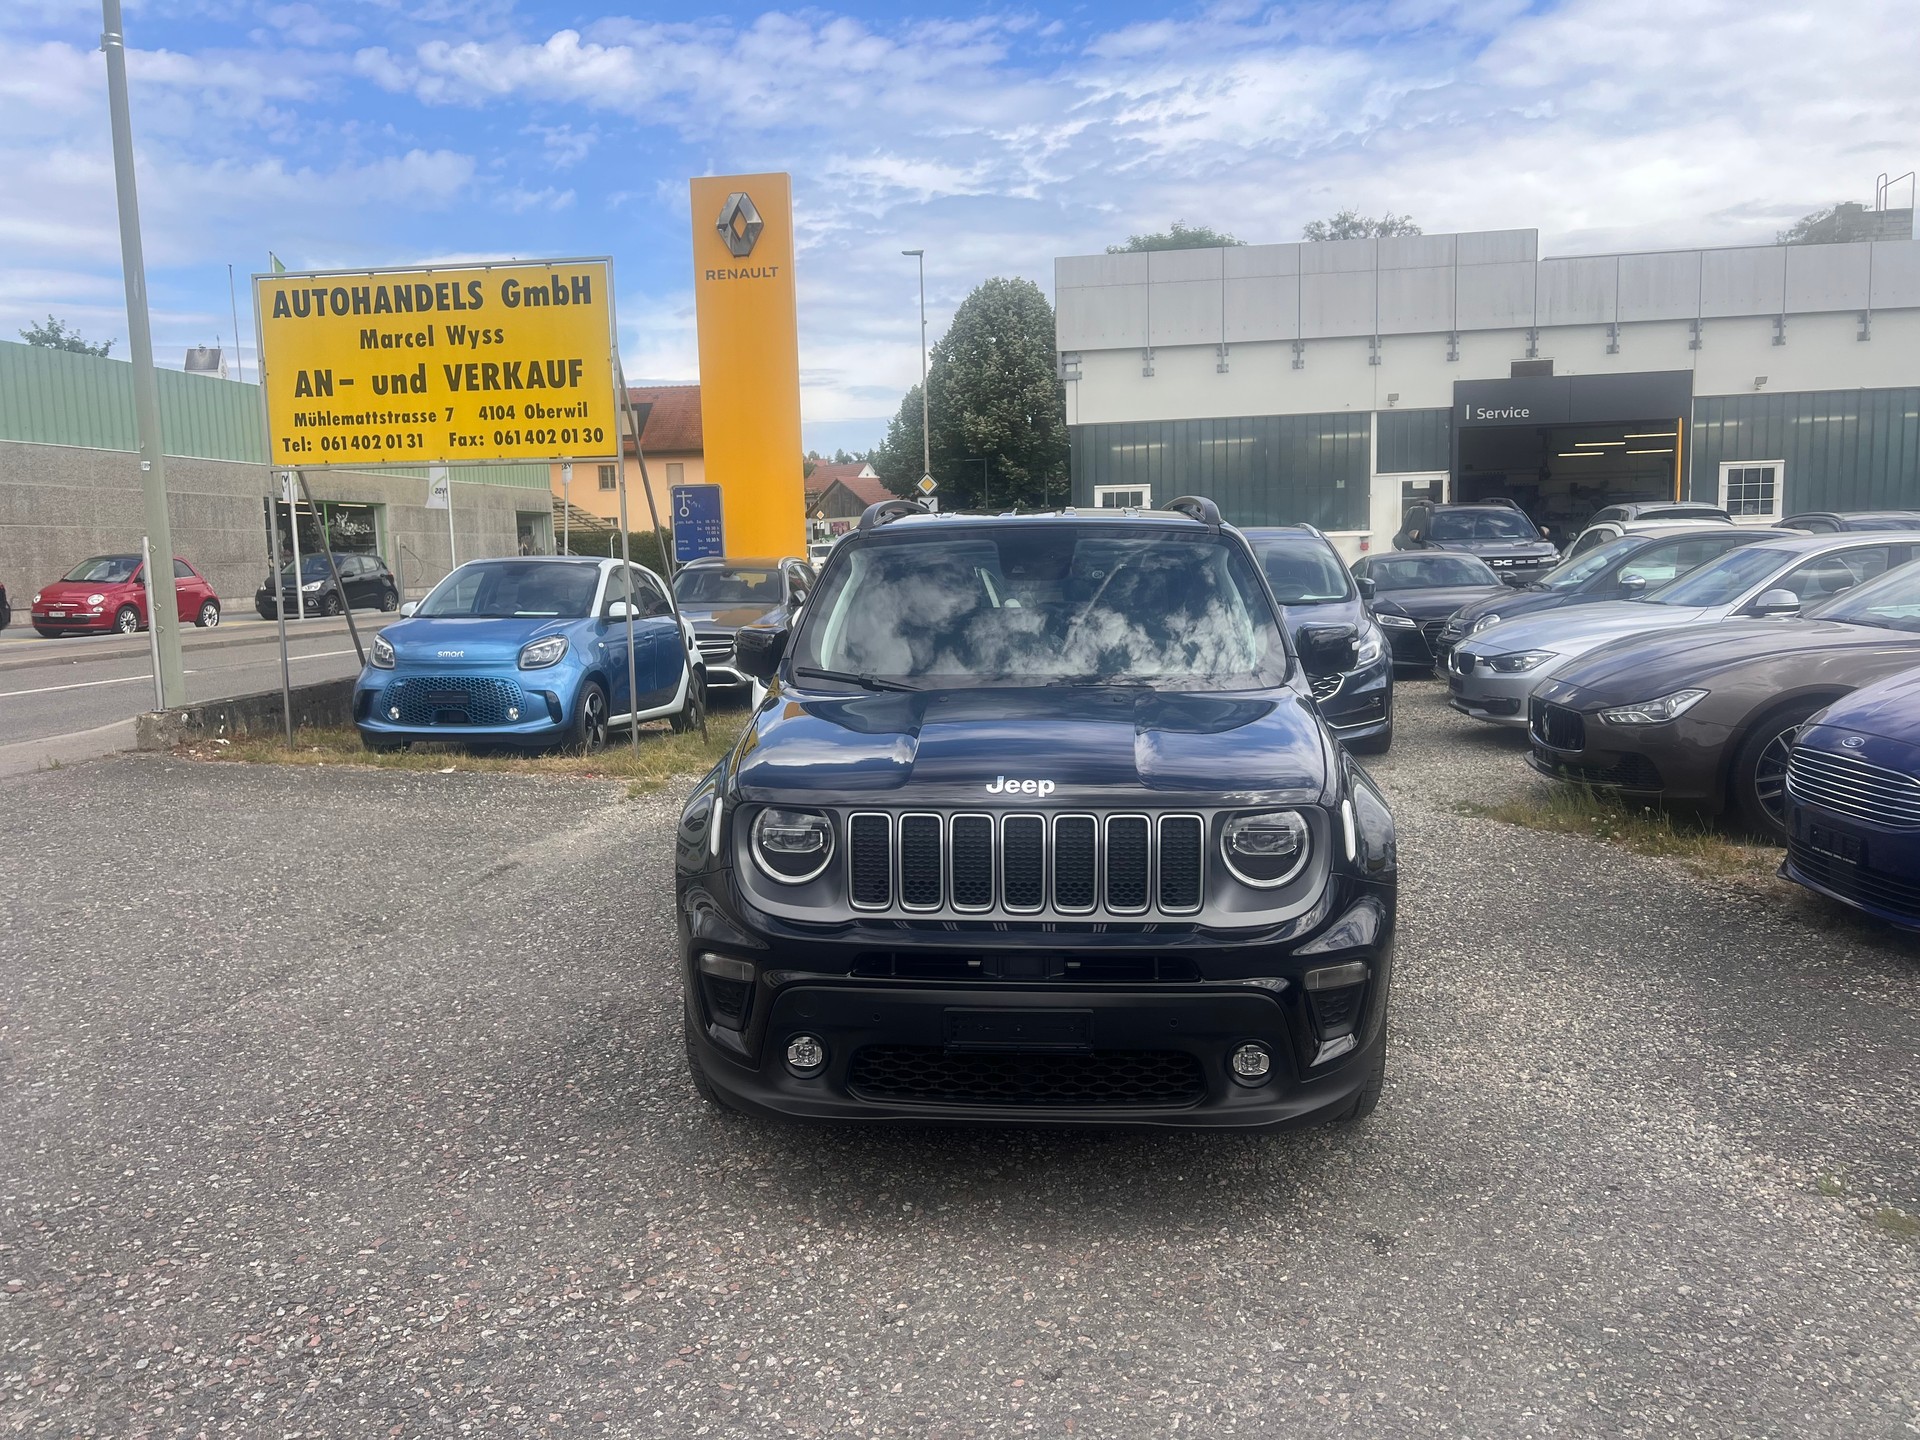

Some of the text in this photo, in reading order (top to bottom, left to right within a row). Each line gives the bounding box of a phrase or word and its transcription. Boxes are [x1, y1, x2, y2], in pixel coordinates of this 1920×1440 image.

[705, 266, 779, 281] RENAULT
[272, 274, 592, 319] AUTOHANDELS GmbH
[360, 324, 505, 350] Marcel Wyss
[372, 363, 427, 395] und
[443, 358, 583, 392] VERKAUF
[294, 401, 588, 428] Mühlemattstrasse 7 4104 Oberwil
[1476, 406, 1530, 420] Service
[282, 436, 312, 453] Tel:
[449, 432, 484, 447] Fax:
[437, 650, 465, 658] smart
[985, 775, 1055, 798] Jeep
